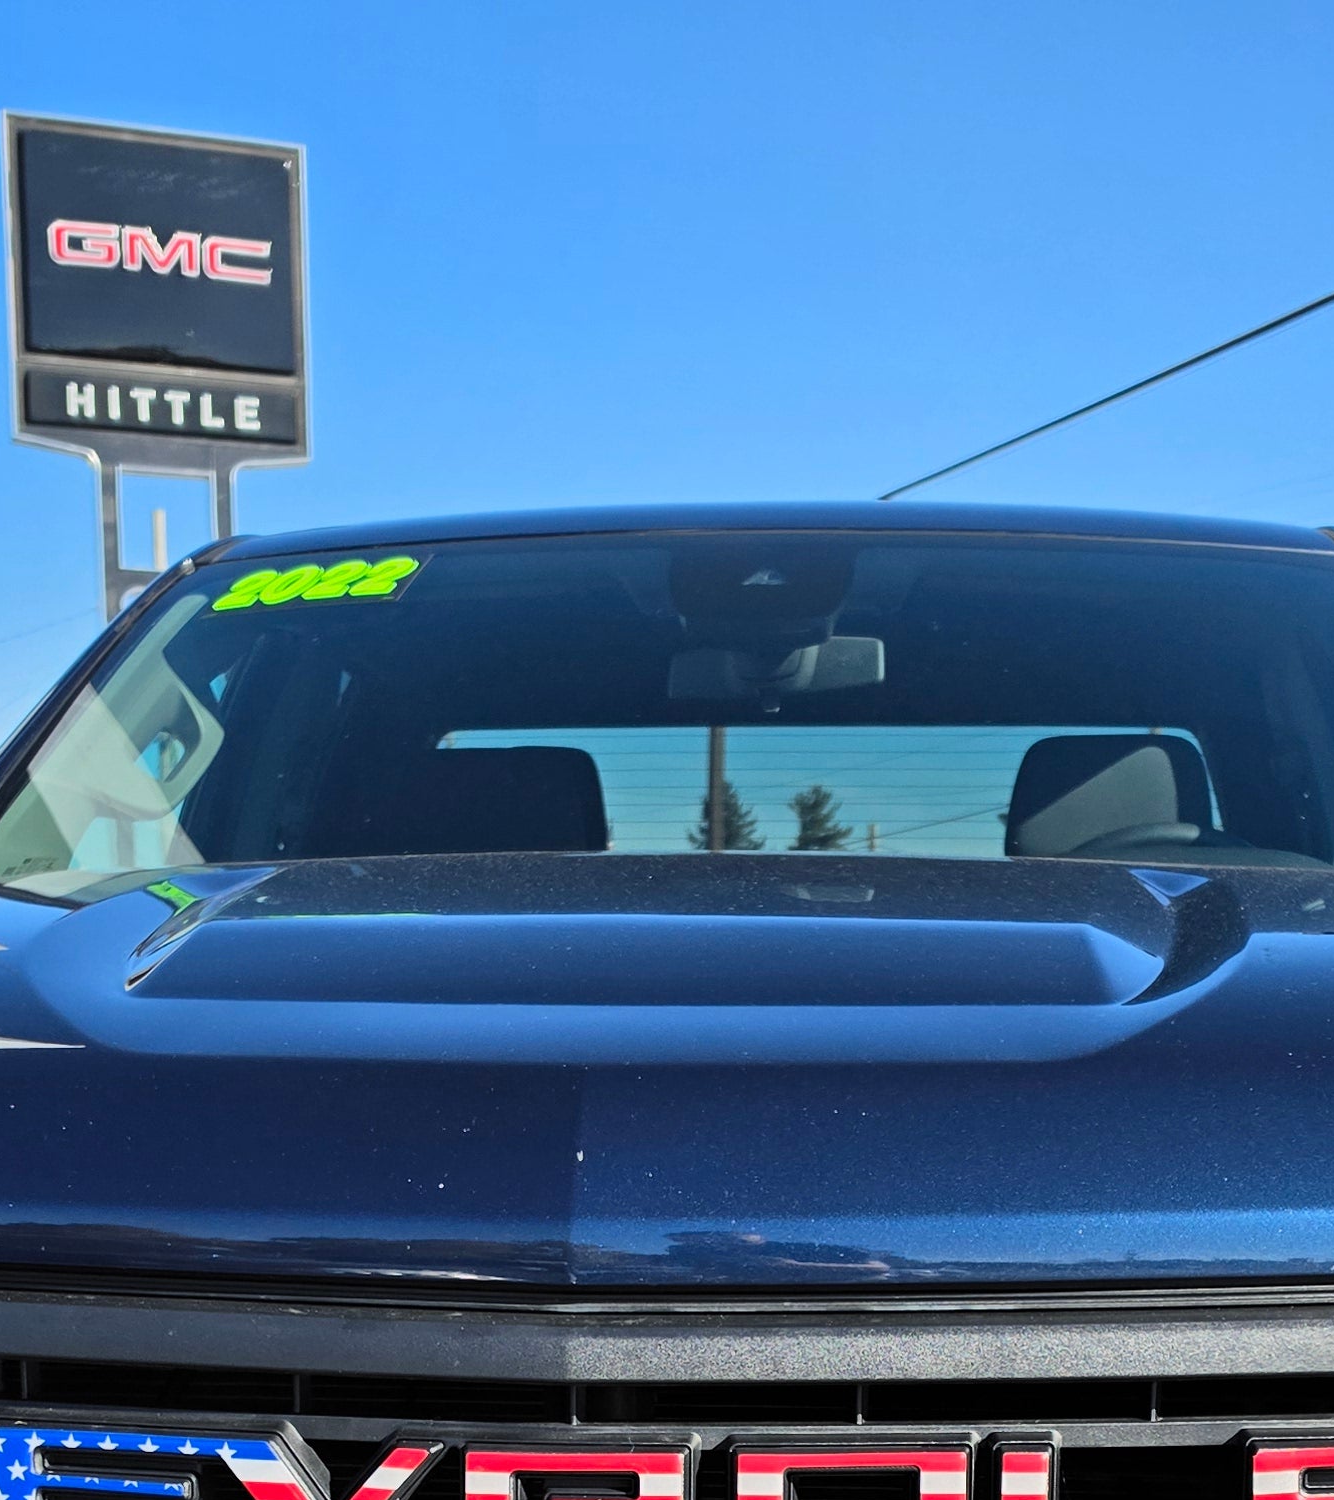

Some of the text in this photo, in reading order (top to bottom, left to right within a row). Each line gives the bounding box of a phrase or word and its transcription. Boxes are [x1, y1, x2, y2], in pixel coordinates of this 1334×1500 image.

[47, 218, 272, 286] GMC
[65, 380, 262, 432] HITTLE
[211, 555, 420, 612] 2022
